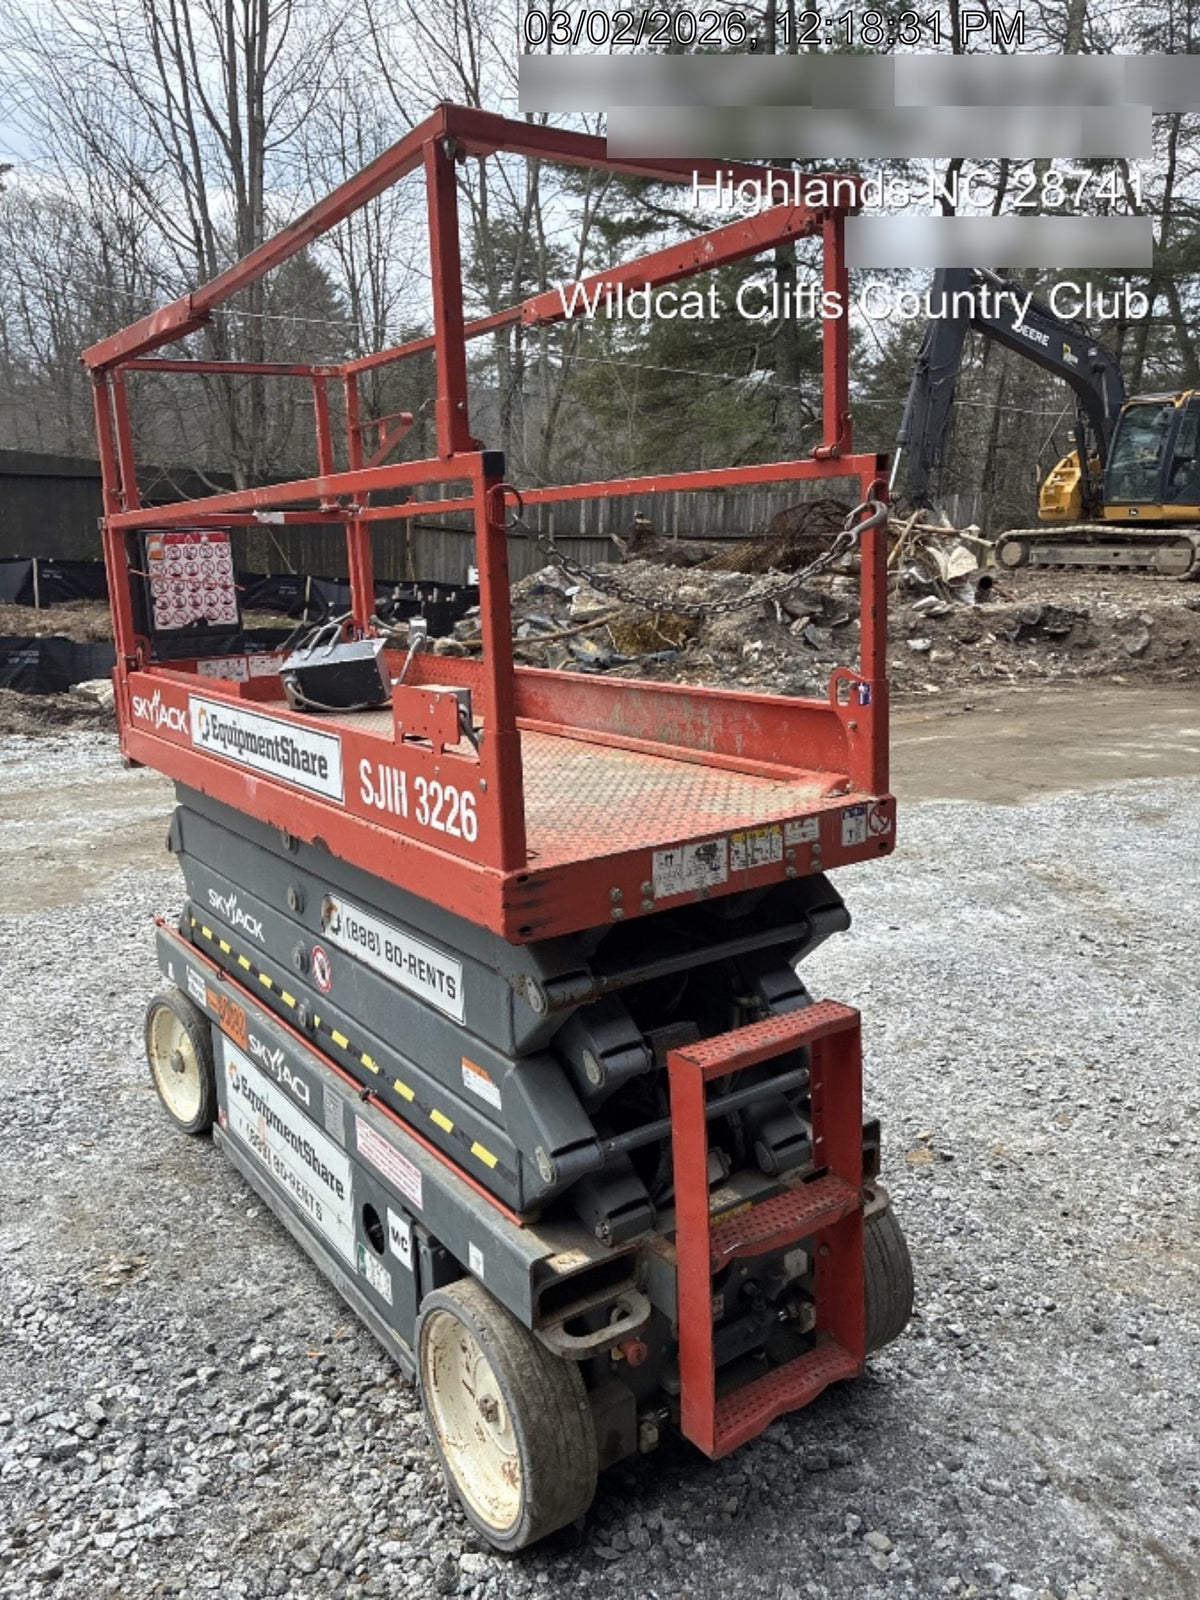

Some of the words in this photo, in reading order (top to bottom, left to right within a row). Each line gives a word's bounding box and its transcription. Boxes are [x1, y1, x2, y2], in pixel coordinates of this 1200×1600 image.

[132, 688, 189, 735] SKYJACK
[210, 713, 329, 780] EquipmentShare
[413, 776, 479, 842] 3226
[208, 887, 266, 943] SKYJACK
[346, 916, 382, 957] (888)
[384, 940, 457, 1000] 80-RENTS
[241, 1074, 345, 1201] EquipmentShare
